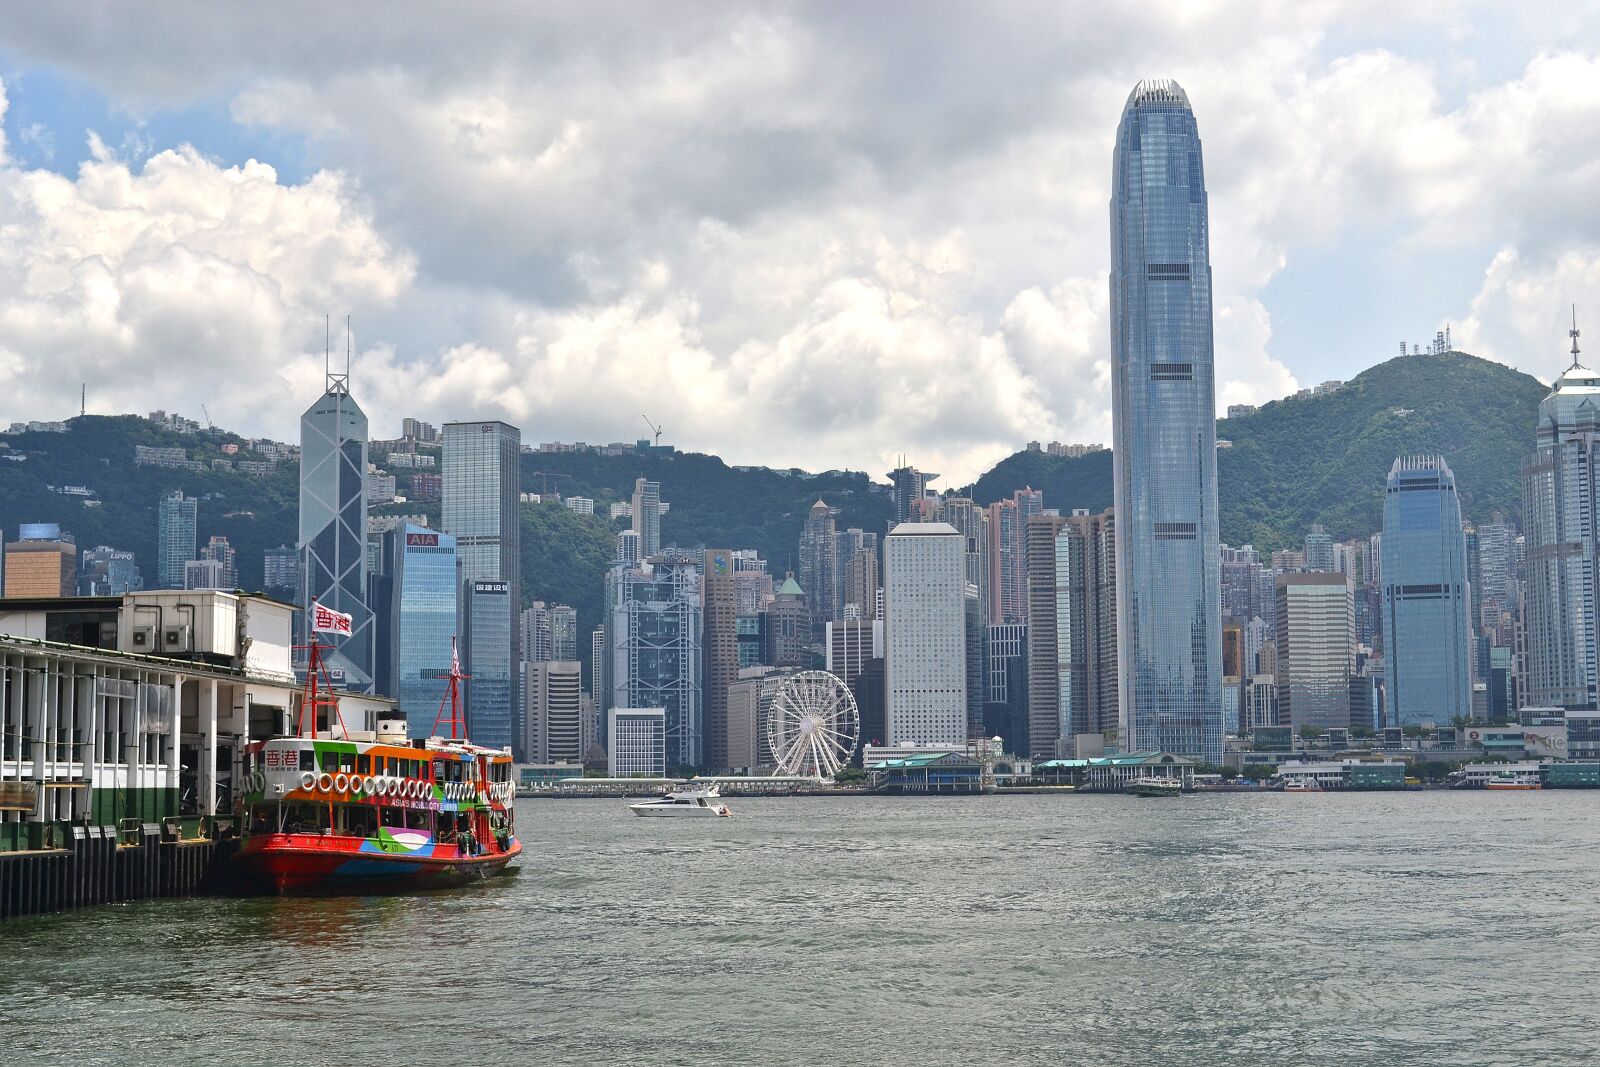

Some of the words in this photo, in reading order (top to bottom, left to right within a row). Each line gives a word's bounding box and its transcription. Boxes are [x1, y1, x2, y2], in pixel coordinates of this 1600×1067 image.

[411, 535, 435, 545] AIA
[316, 606, 350, 631] 香港
[267, 750, 298, 766] 香港
[391, 799, 410, 807] ASIA'S
